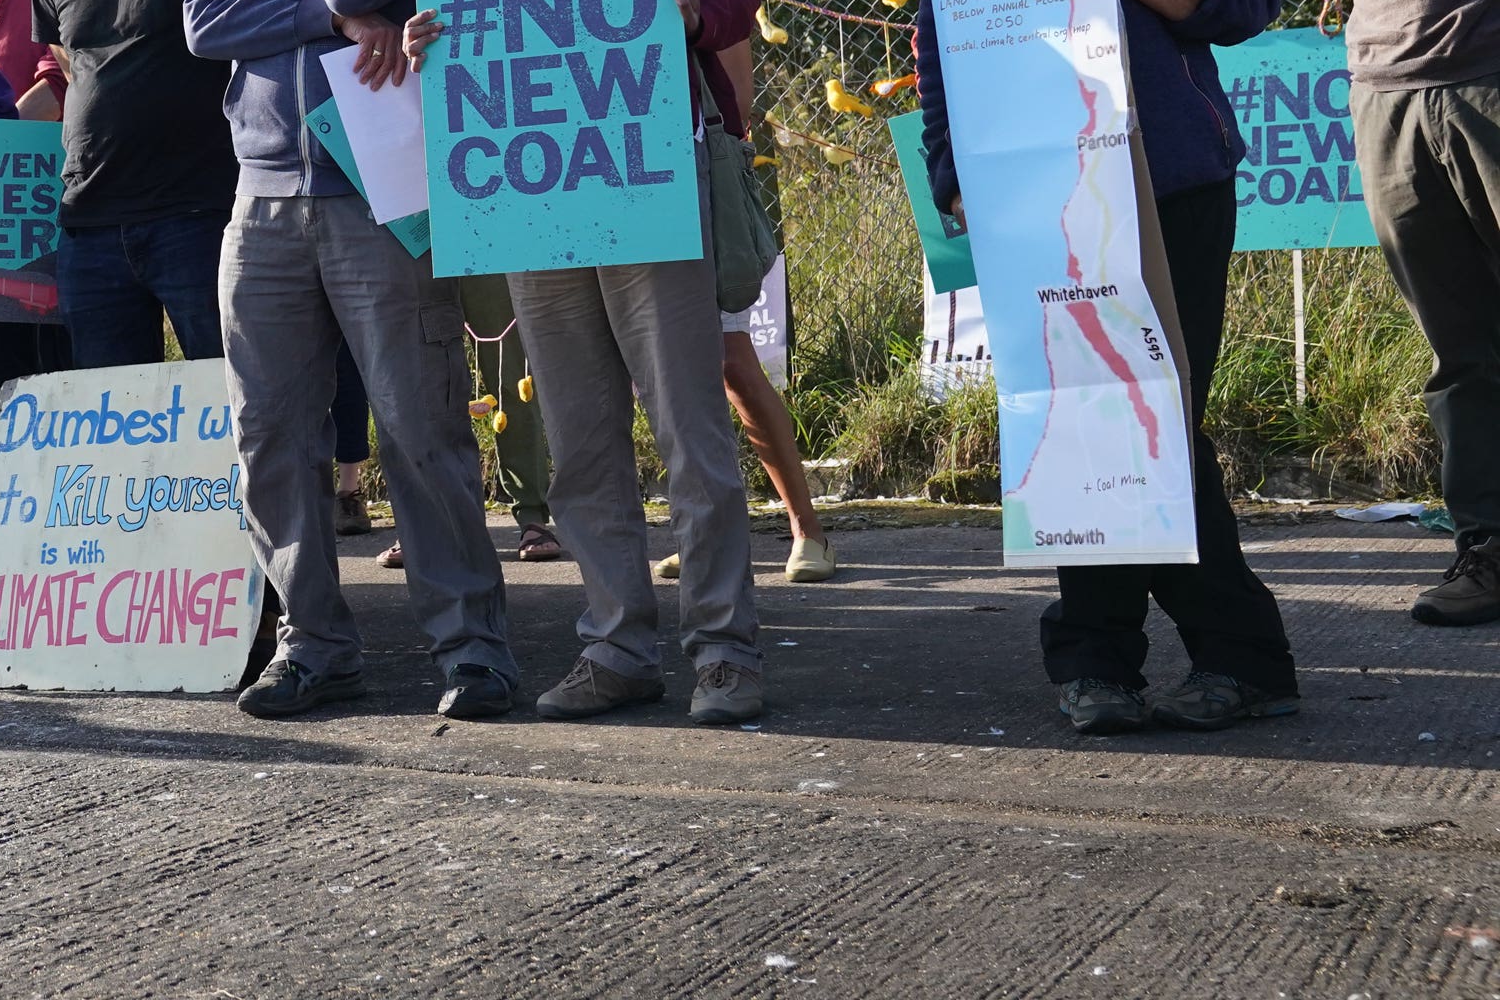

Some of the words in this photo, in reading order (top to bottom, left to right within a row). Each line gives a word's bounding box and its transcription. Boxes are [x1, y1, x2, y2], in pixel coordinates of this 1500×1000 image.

[952, 7, 985, 21] BELOW
[992, 0, 1030, 14] ANNUAL
[986, 14, 1023, 30] 2050
[444, 43, 663, 133] NEW
[1228, 69, 1353, 123] #NO
[1077, 132, 1126, 151] Parton
[447, 122, 675, 200] COAL
[1237, 165, 1364, 207] COAL
[1037, 284, 1118, 305] Whitehaven
[1140, 327, 1164, 361] A595
[44, 464, 112, 529] Kill
[1097, 477, 1115, 493] Coal
[1035, 528, 1105, 547] Sandwith
[41, 542, 58, 565] is
[67, 540, 105, 565] with
[95, 567, 245, 647] CHANGE
